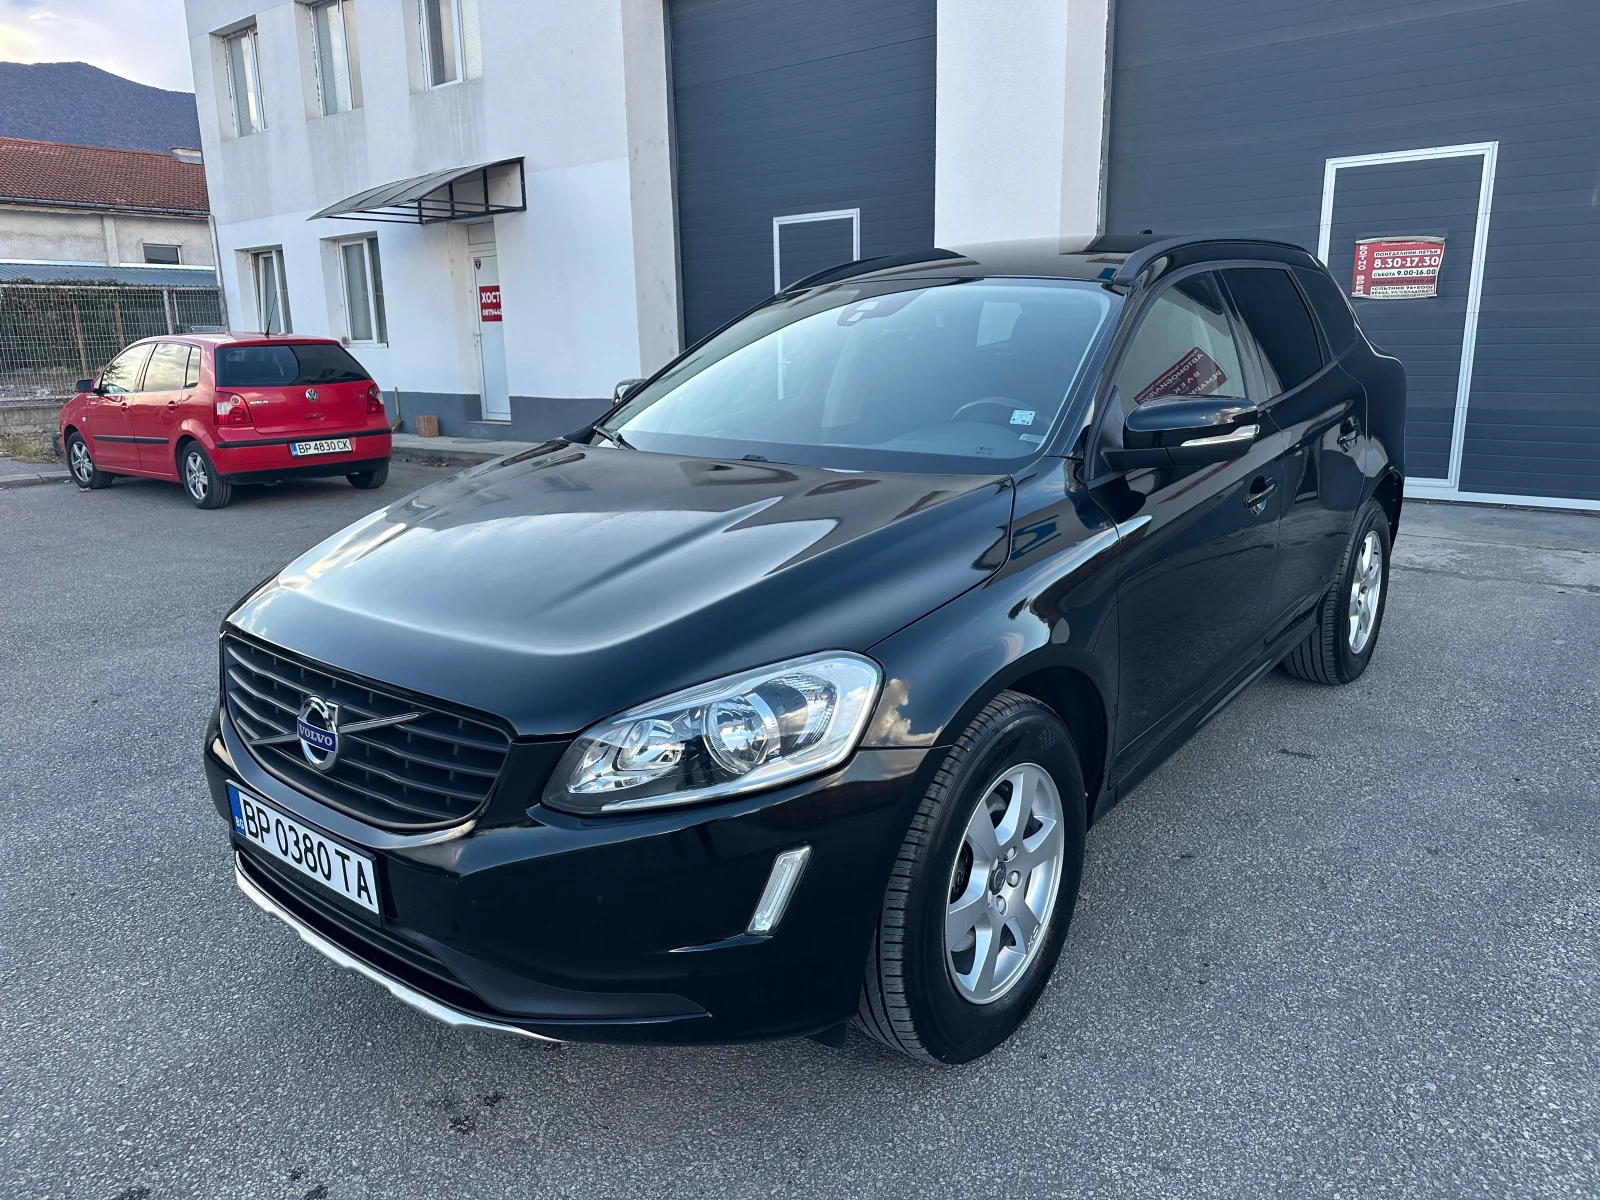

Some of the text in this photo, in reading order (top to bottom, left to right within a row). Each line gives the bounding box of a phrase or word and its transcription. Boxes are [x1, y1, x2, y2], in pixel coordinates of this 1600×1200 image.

[1374, 257, 1439, 268] 8.30-17.30
[1396, 268, 1436, 276] 9.00-16.00
[481, 292, 500, 303] ХОСТ
[298, 443, 312, 454] BP
[313, 441, 336, 453] 4830
[338, 440, 350, 451] CK
[298, 723, 333, 747] VOLVO
[234, 815, 246, 831] BG
[242, 798, 374, 906] BP 0380 TA
